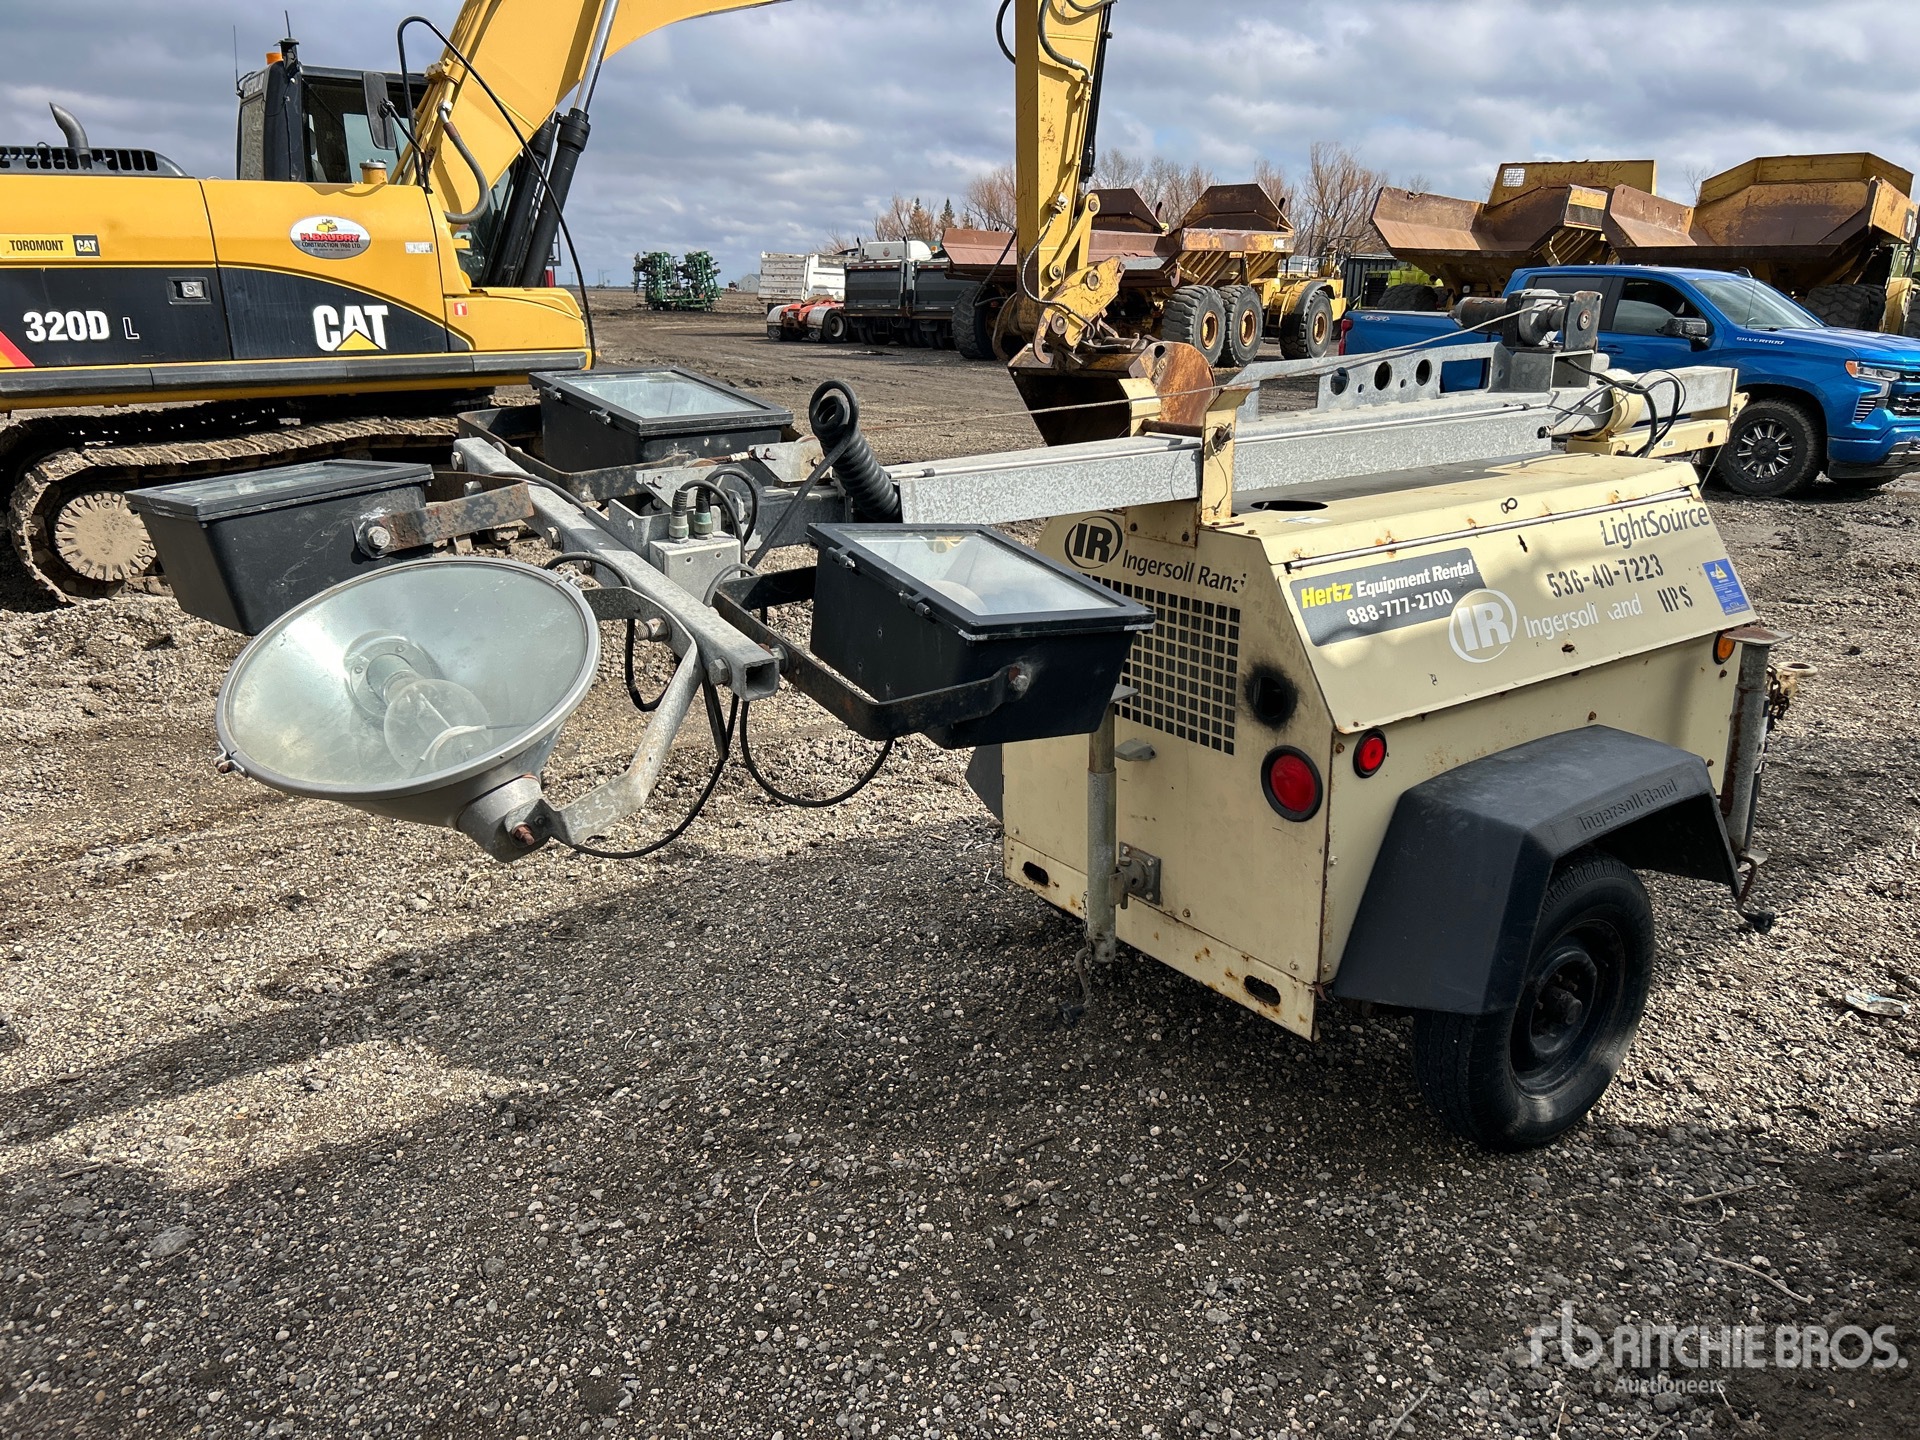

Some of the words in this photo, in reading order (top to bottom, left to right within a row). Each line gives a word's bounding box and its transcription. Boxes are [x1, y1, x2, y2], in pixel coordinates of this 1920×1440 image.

[9, 240, 64, 251] TOROMONT
[76, 239, 96, 252] CAT
[23, 311, 109, 341] 320D
[122, 317, 140, 340] L
[313, 305, 388, 352] CAT
[1600, 507, 1710, 549] LightSource
[1122, 549, 1195, 583] Ingersoll
[1301, 582, 1353, 609] Hertz
[1356, 568, 1430, 598] Equipment
[1431, 559, 1474, 581] Rental
[1546, 553, 1664, 598] 536-40-7223
[1346, 588, 1453, 625] 888-777-2700
[1455, 601, 1512, 652] IR
[1523, 602, 1599, 640] Ingersoll
[1606, 592, 1643, 620] and
